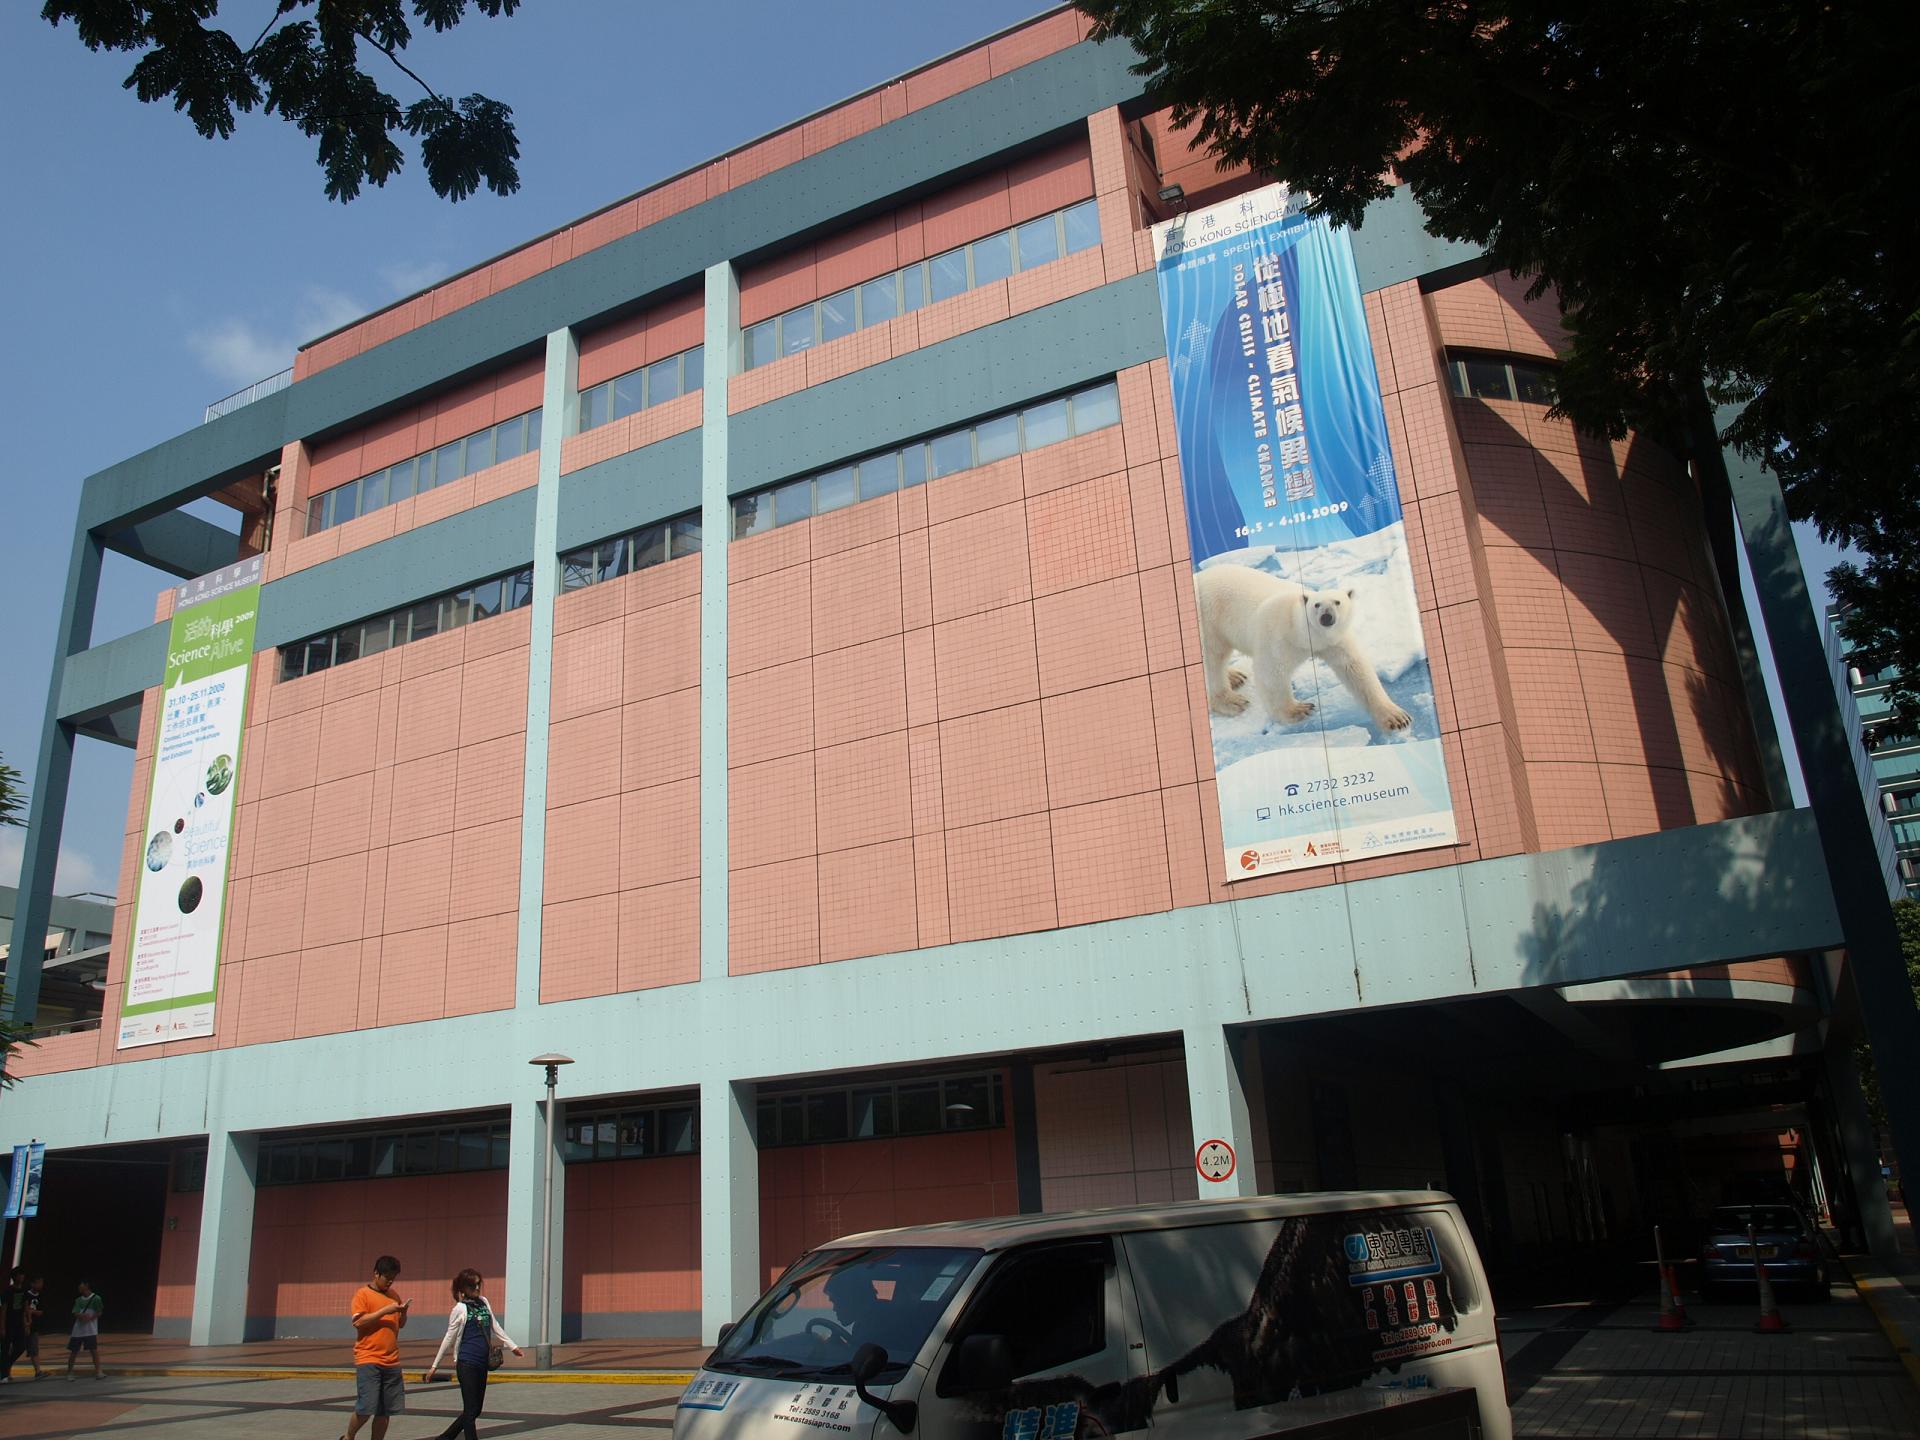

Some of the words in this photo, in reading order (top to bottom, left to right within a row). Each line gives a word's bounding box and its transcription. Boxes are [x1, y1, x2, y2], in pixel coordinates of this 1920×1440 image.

[1165, 238, 1197, 255] HONG
[1200, 226, 1231, 245] KONG
[1235, 208, 1284, 231] SCIENCE
[1223, 239, 1266, 257] SPECIAL
[1233, 263, 1248, 309] POLAR
[1239, 313, 1255, 357] CRISIS
[1247, 374, 1268, 439] CLIMATE
[1257, 443, 1277, 508] CHANGE
[1234, 522, 1263, 538] 16.5
[234, 572, 259, 587] MUSEUM
[235, 610, 255, 624] 2009
[169, 644, 211, 669] Science
[210, 638, 245, 661] Alive
[1307, 778, 1338, 793] 2732
[1343, 771, 1375, 787] 3232
[1279, 785, 1410, 817] hk.science.museum
[1203, 1155, 1230, 1167] 4.2M
[1366, 1227, 1428, 1259] 東亞專業
[1401, 1328, 1418, 1340] 2889
[1419, 1324, 1437, 1337] 3168
[1375, 1337, 1452, 1361] www.eastasiapro.com
[773, 1413, 851, 1433] www.eastasiapro.com
[803, 1407, 820, 1417] 2889
[821, 1410, 840, 1420] 3168
